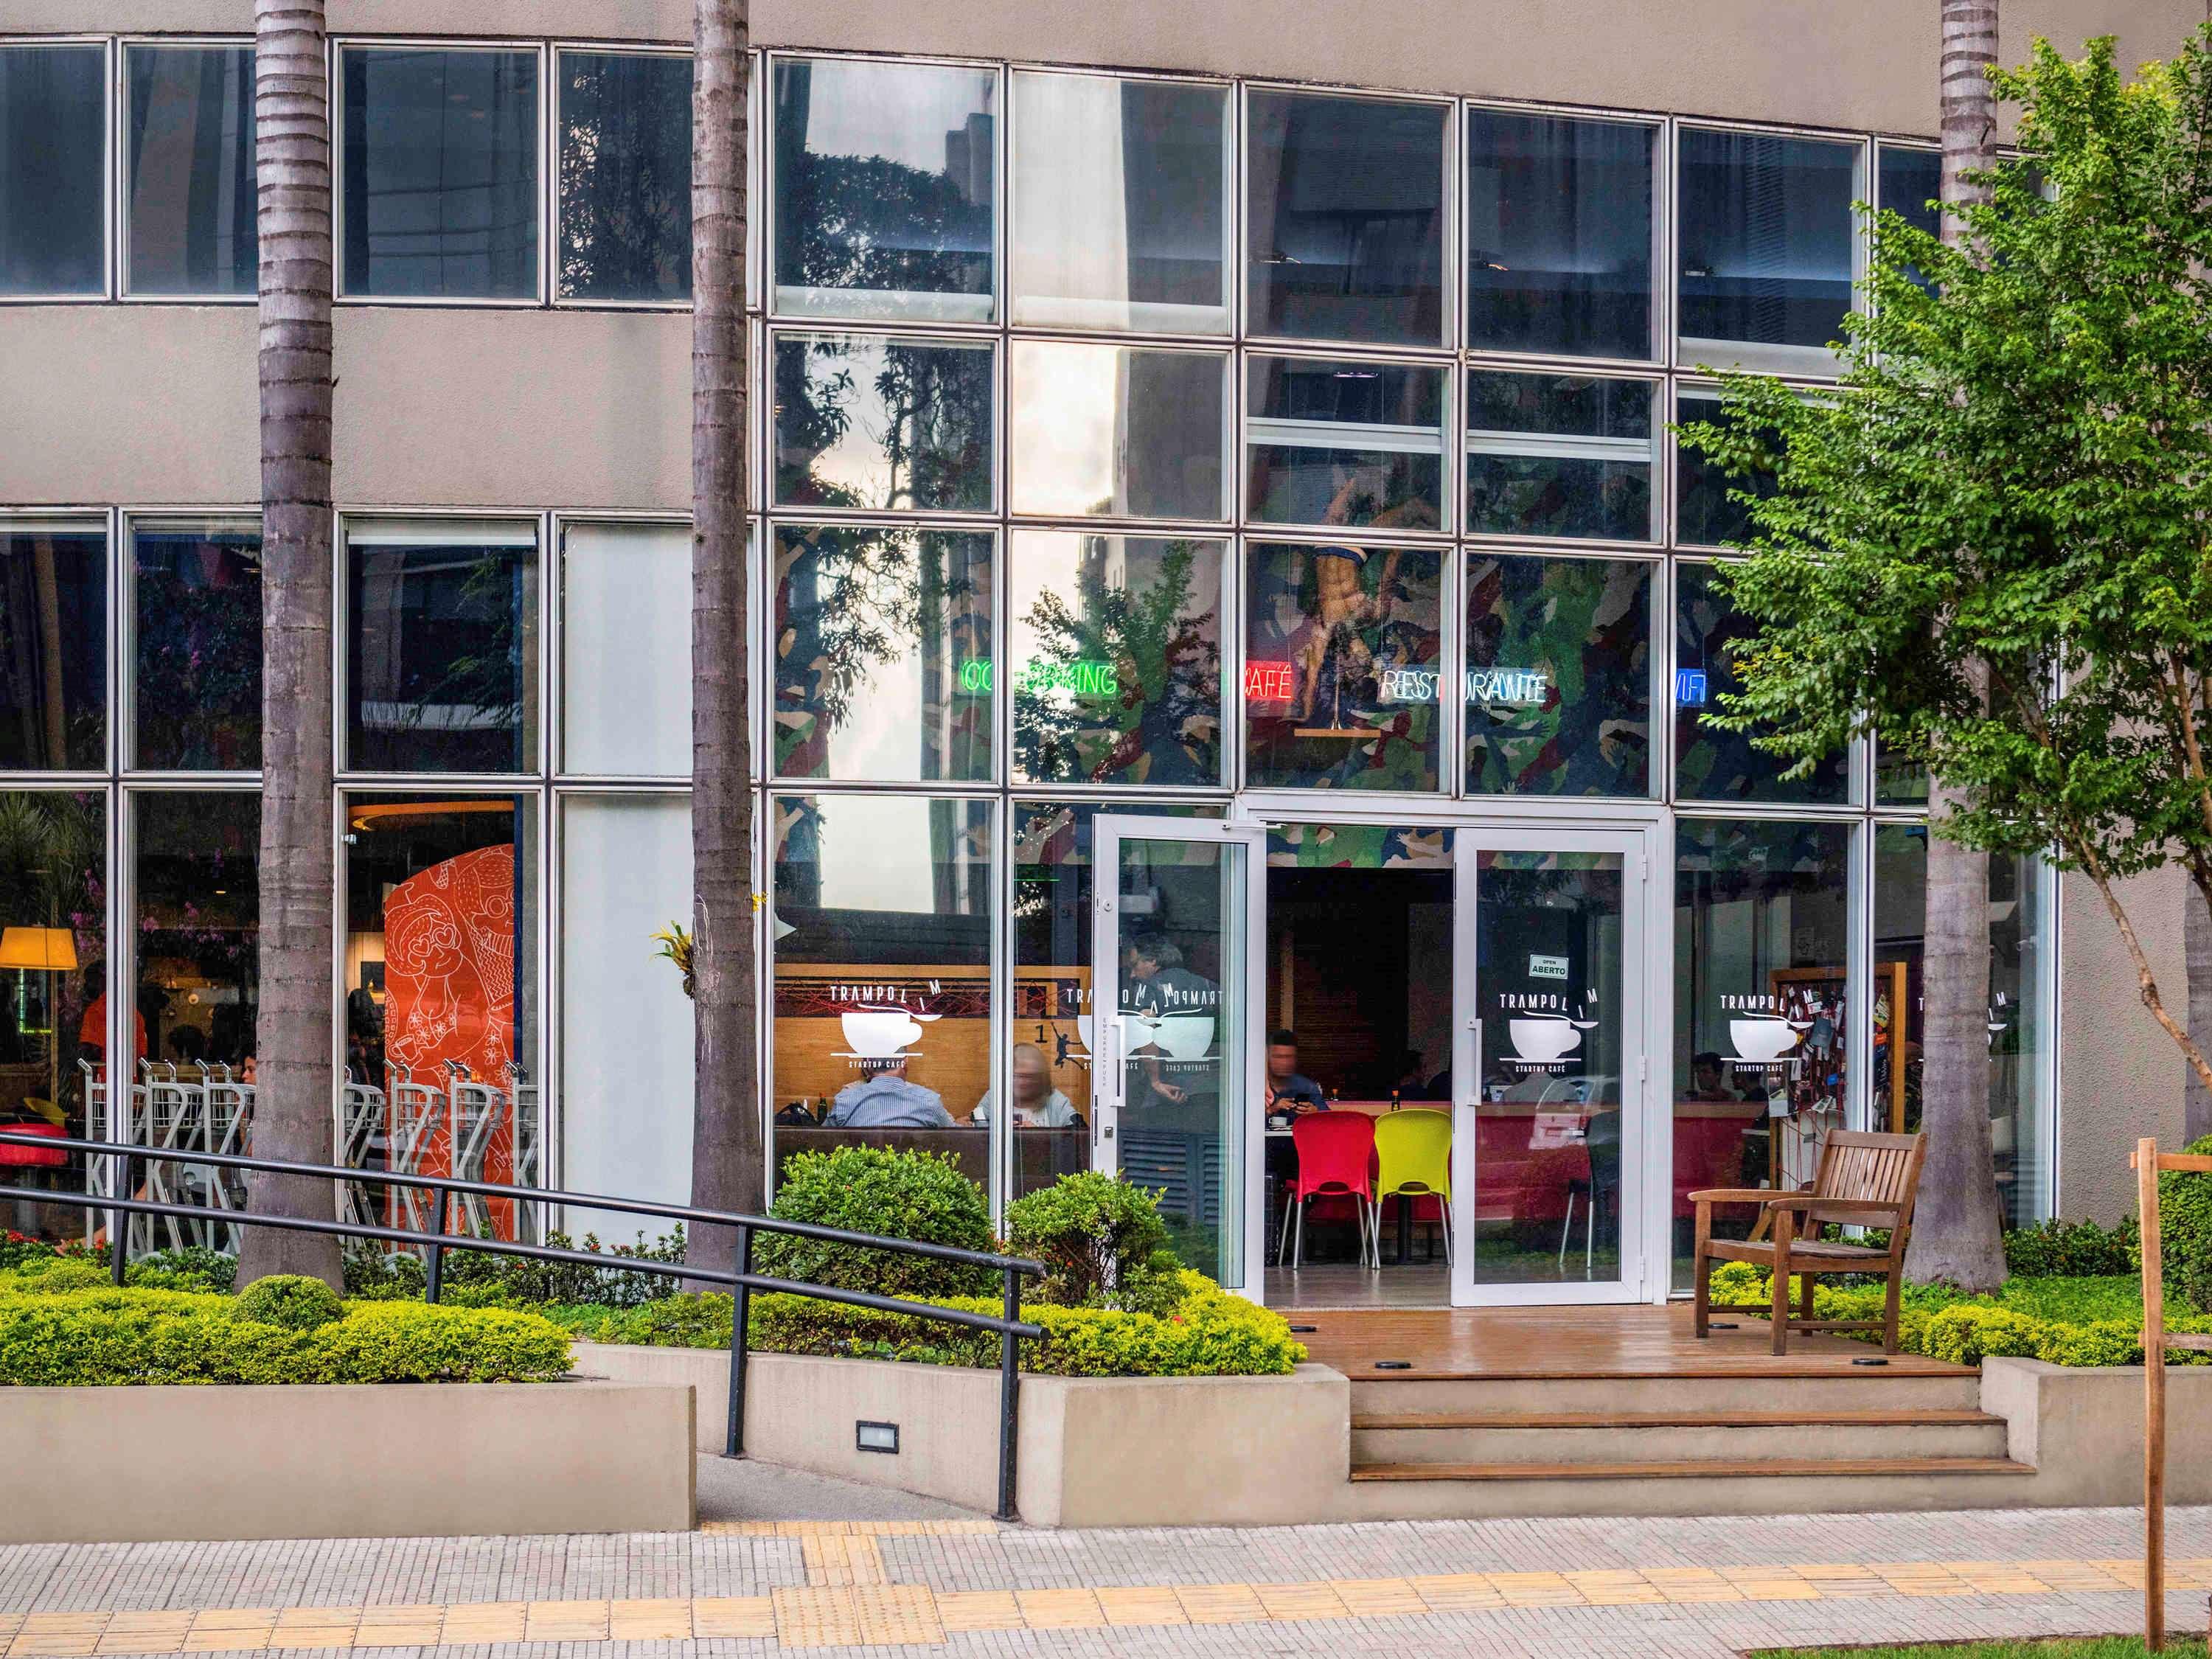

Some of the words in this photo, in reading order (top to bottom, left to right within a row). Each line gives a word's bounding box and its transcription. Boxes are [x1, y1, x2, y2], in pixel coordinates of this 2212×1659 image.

[961, 661, 1117, 694] COORKING
[1381, 670, 1548, 703] RESTRANTE
[1675, 673, 1705, 702] IFI
[1532, 966, 1565, 975] ABERTO
[830, 979, 941, 1011] TRAMPOLIM
[1500, 988, 1598, 1019] TRAMPOLIM
[1720, 990, 1813, 1019] TRAMPOLIM
[1035, 1025, 1047, 1043] 1
